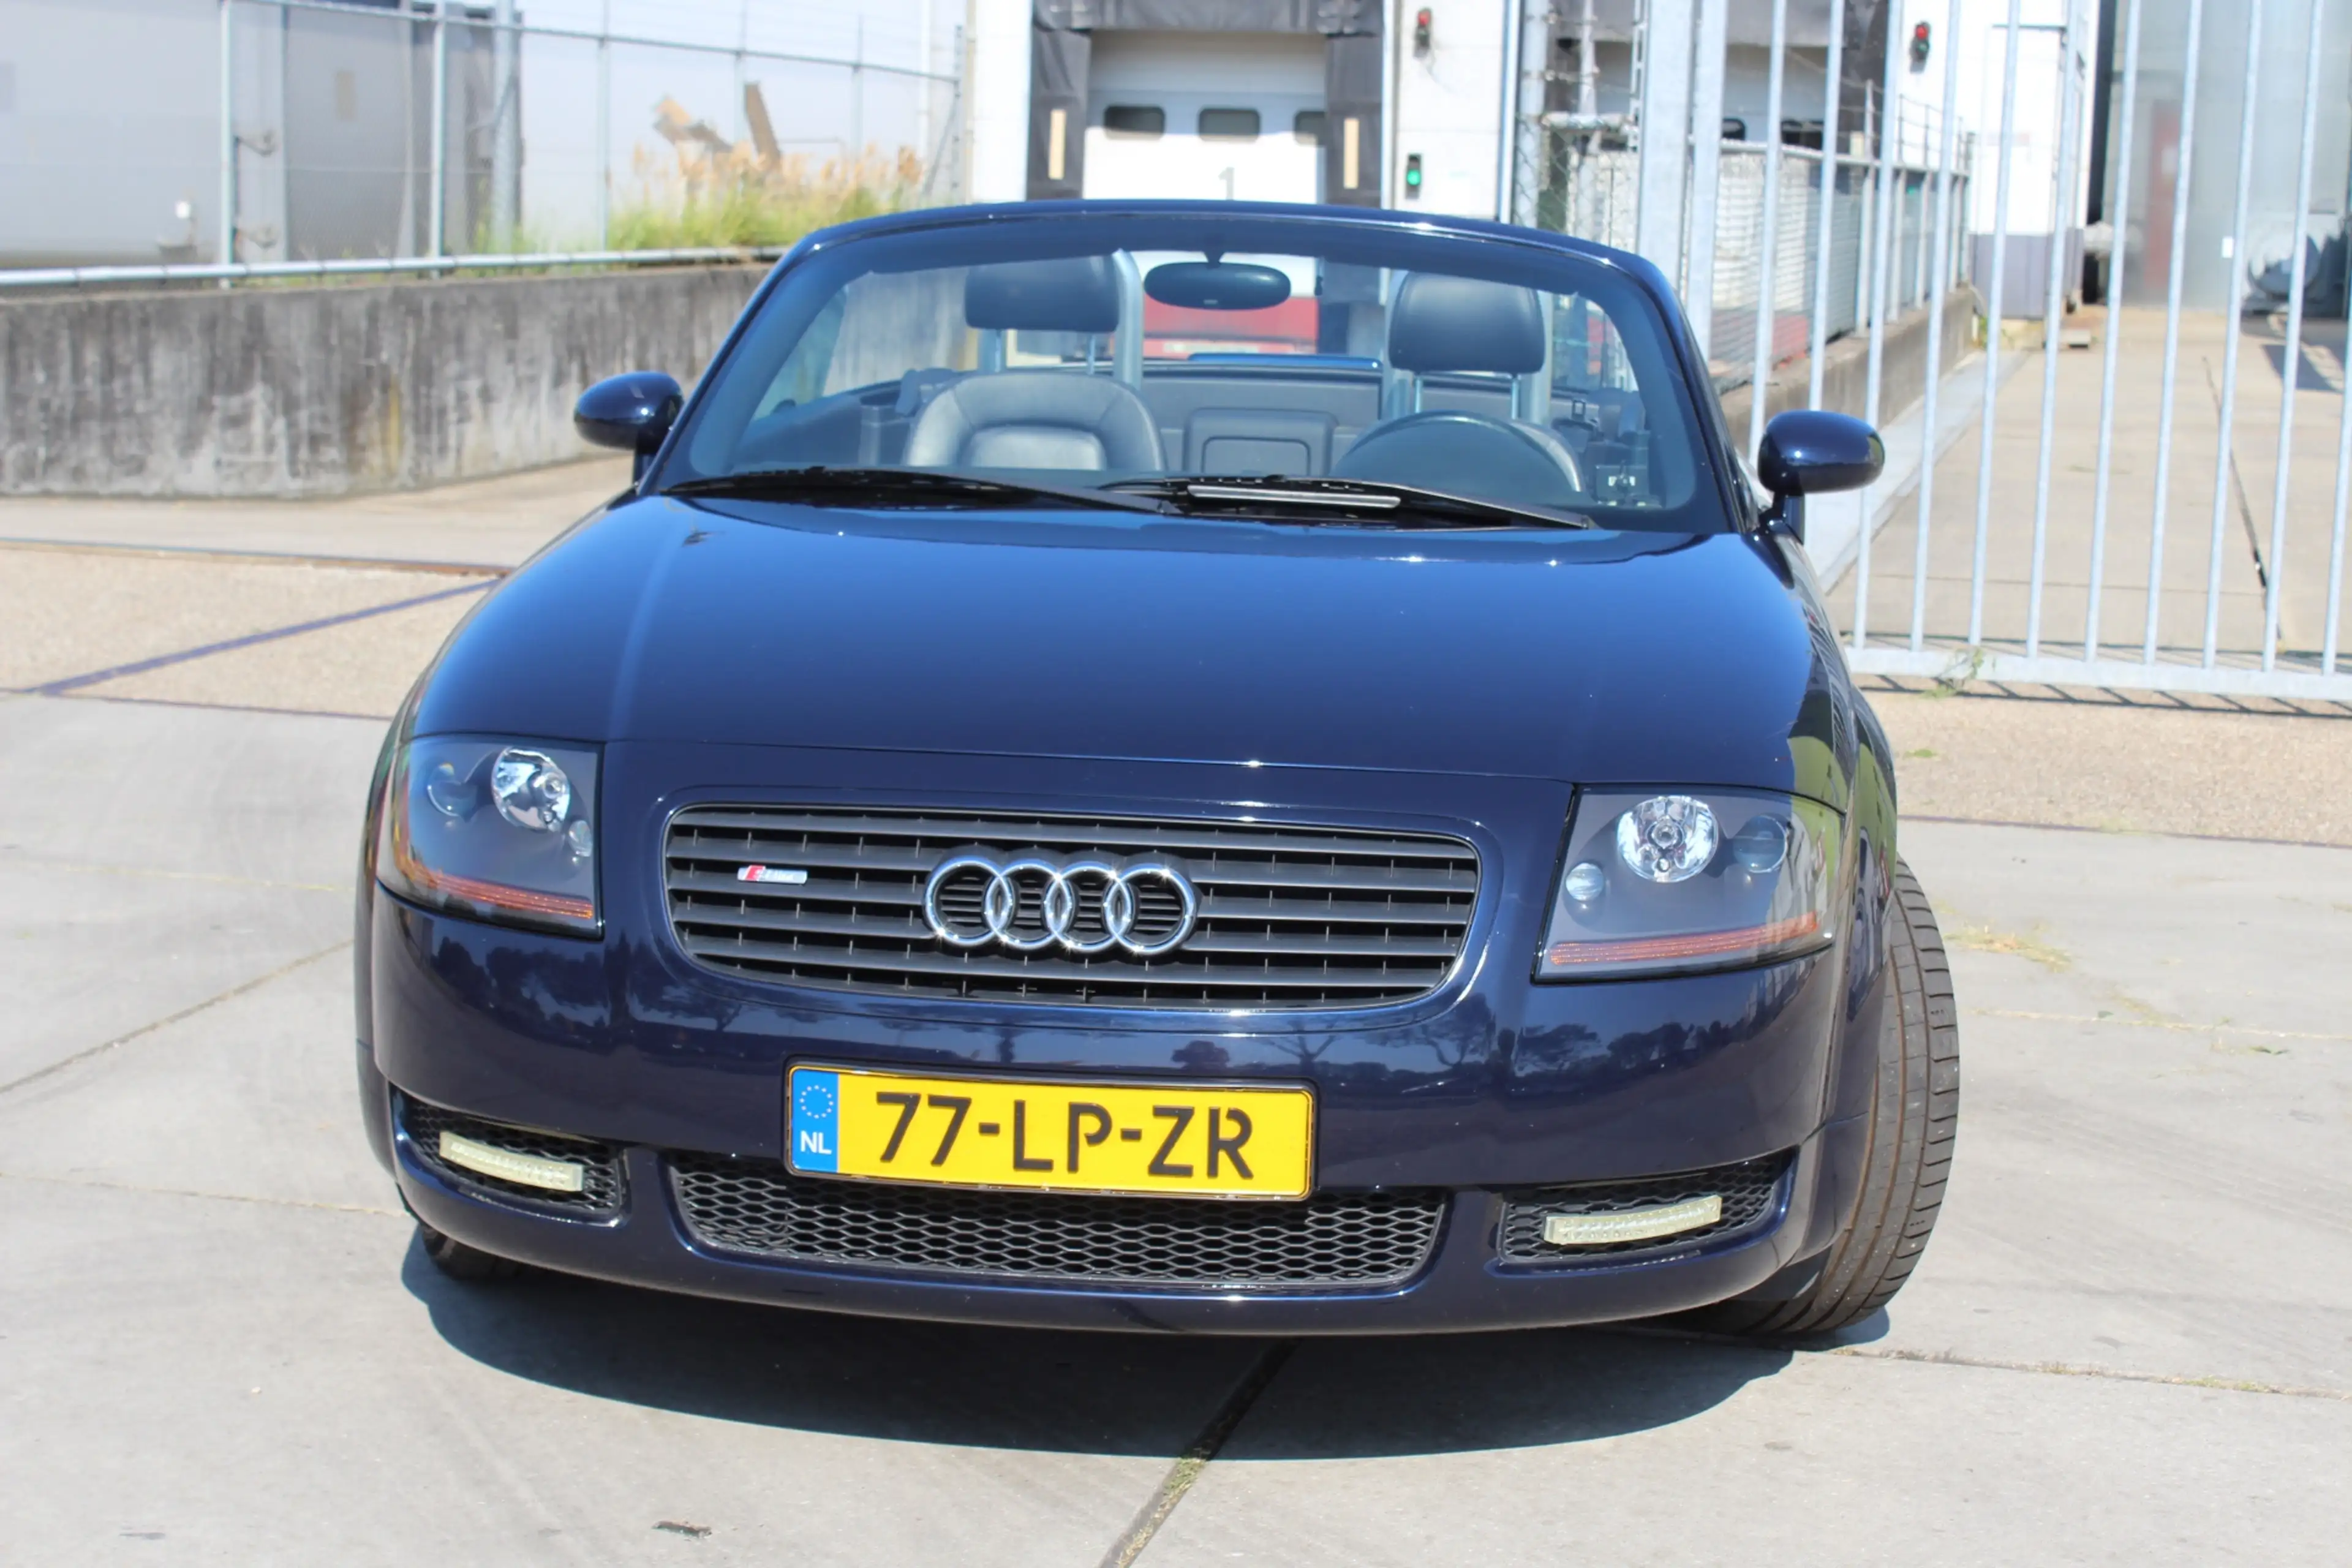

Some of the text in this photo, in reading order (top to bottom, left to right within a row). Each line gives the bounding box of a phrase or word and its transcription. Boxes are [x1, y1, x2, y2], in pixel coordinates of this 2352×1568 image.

[1218, 166, 1235, 200] 1
[801, 1130, 832, 1155] NL
[877, 1093, 1253, 1178] 77-LP-ZR
